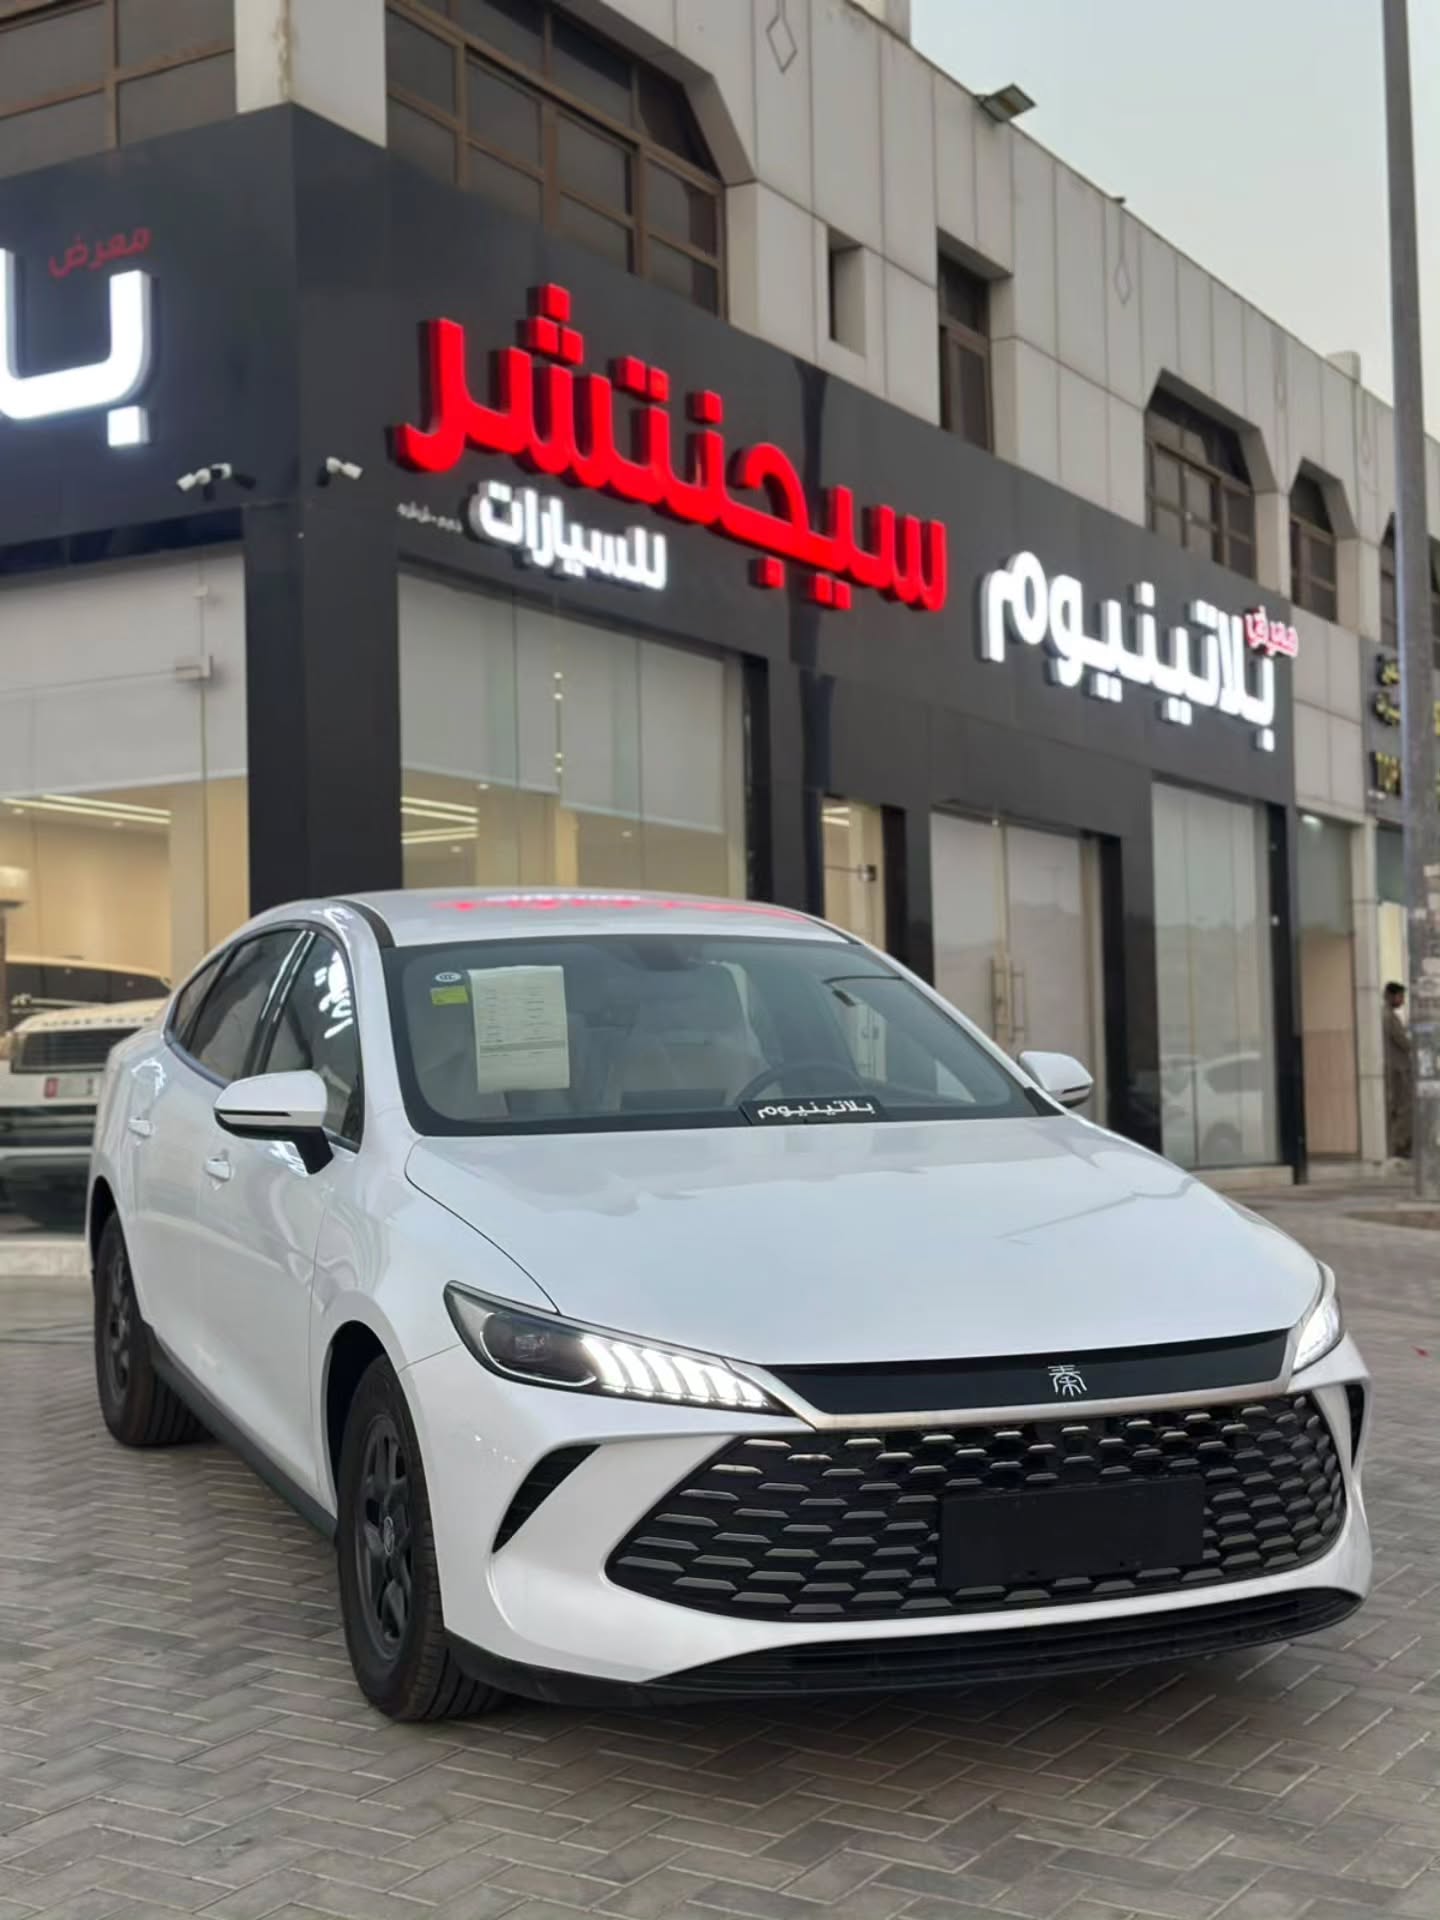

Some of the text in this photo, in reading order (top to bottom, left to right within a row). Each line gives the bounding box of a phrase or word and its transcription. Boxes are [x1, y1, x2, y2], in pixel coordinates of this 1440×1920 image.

[49, 228, 152, 278] معرض
[397, 283, 946, 612] سيجنتشر
[475, 481, 667, 590] للسيارات
[984, 551, 1275, 752] بلاتينيوم
[757, 1100, 876, 1120] بلاتينيوم
